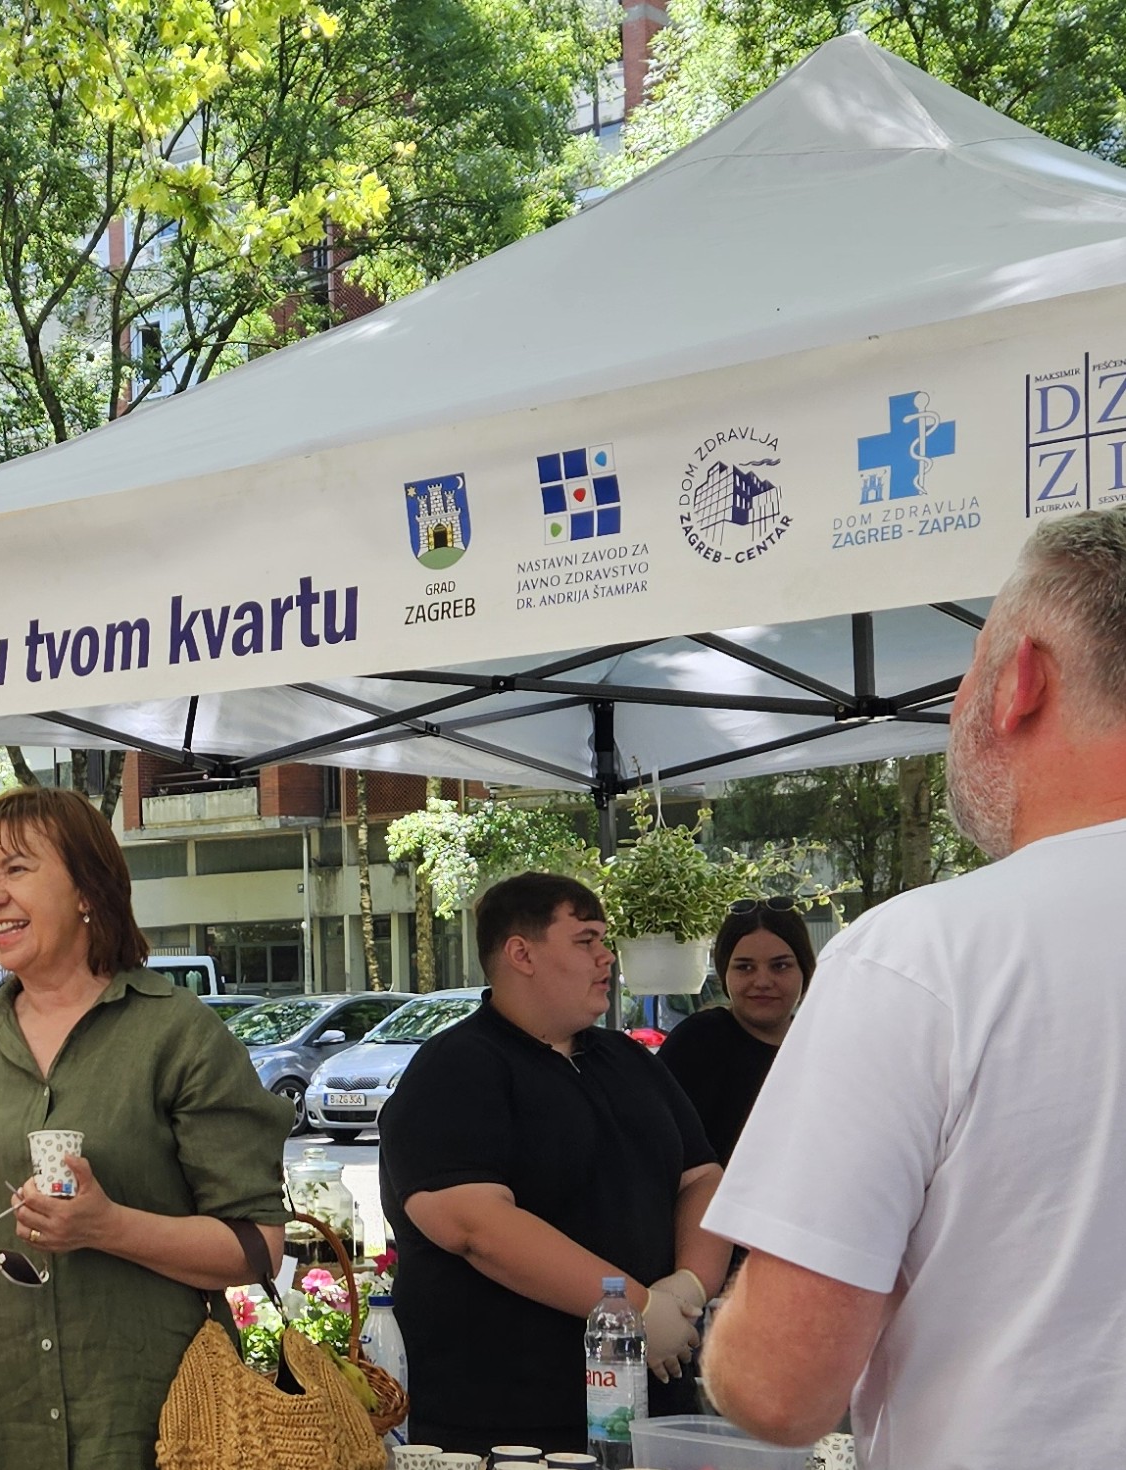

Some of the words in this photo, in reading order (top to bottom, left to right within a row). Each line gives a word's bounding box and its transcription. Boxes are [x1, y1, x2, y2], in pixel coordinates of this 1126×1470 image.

[1034, 368, 1081, 383] MAKSIMIR
[1035, 384, 1081, 435] D
[679, 463, 699, 506] DOM
[694, 426, 779, 461] ZDRAVLJA
[833, 512, 872, 530] DOM
[882, 496, 980, 522] ZDRAVLJA
[1034, 500, 1081, 514] DUBRAVA
[832, 524, 902, 549] ZAGREB
[918, 512, 981, 536] ZAPAD
[516, 553, 578, 574] NASTAVNI
[581, 546, 628, 565] ZAVOD
[631, 543, 649, 557] ZA
[425, 580, 456, 596] GRAD
[516, 574, 561, 595] JAVNO
[564, 561, 649, 585] ZDRAVSTVO
[404, 597, 476, 625] ZAGREB
[516, 596, 536, 610] DR.
[539, 590, 590, 609] ANDRIJA
[592, 580, 649, 599] ŠTAMPAR
[24, 617, 151, 682] tvom
[169, 576, 359, 665] kvartu
